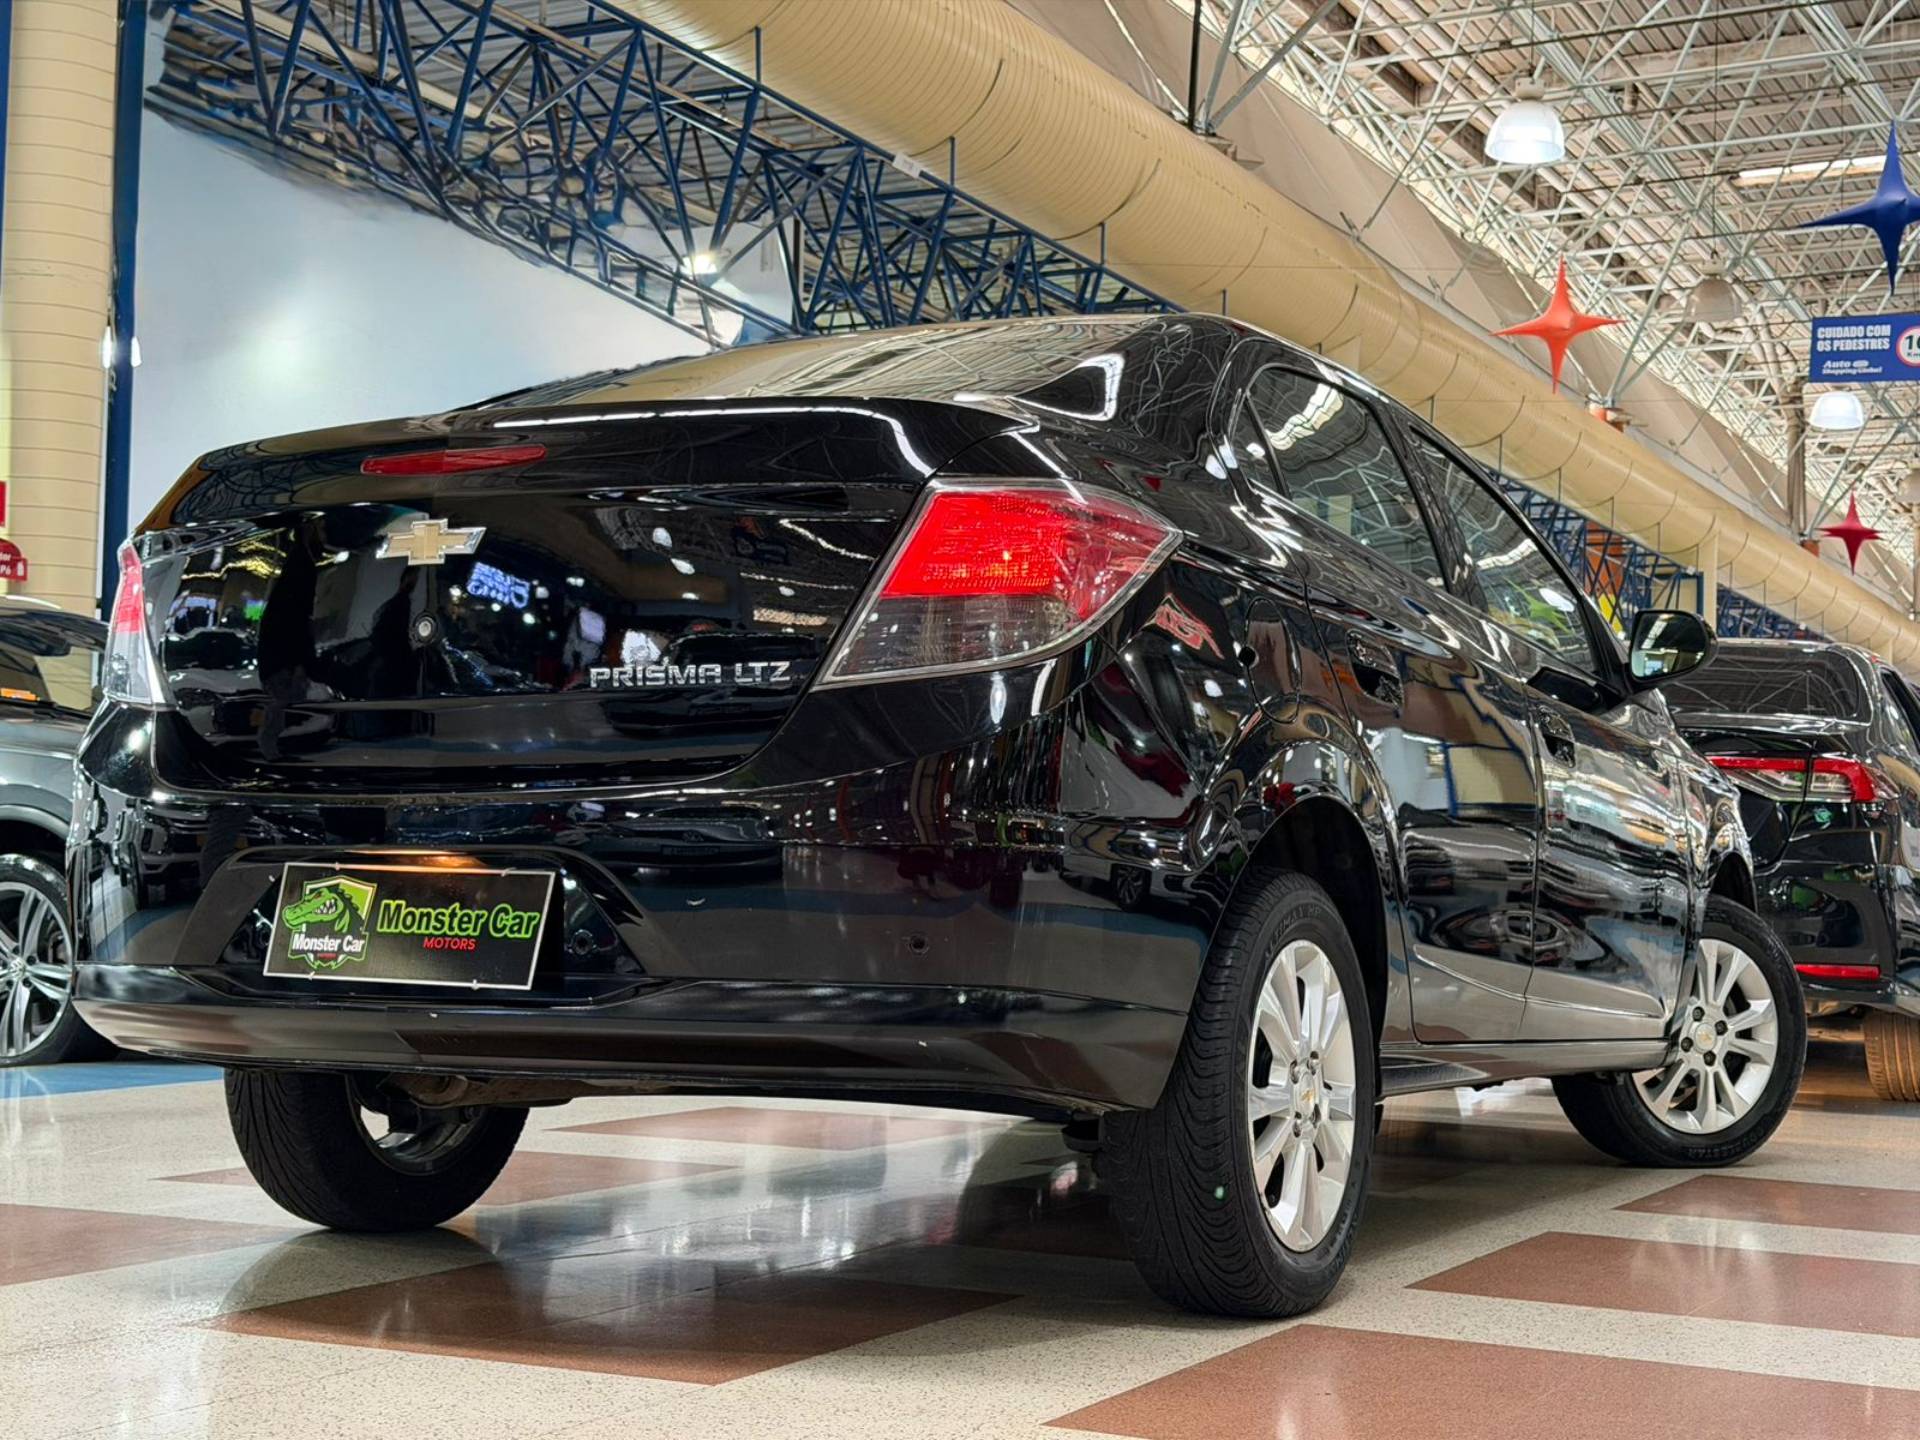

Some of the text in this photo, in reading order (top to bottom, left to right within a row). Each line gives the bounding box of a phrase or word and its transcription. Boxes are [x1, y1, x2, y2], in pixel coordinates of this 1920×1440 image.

[1817, 324, 1891, 339] CUIDADO COM
[1816, 338, 1890, 352] OS PEDESTRES
[1823, 360, 1851, 368] Auto
[589, 661, 791, 688] PRISMA LTZ
[377, 899, 541, 939] Monster Car
[291, 932, 366, 953] Monster Car
[423, 935, 477, 951] MOTORS
